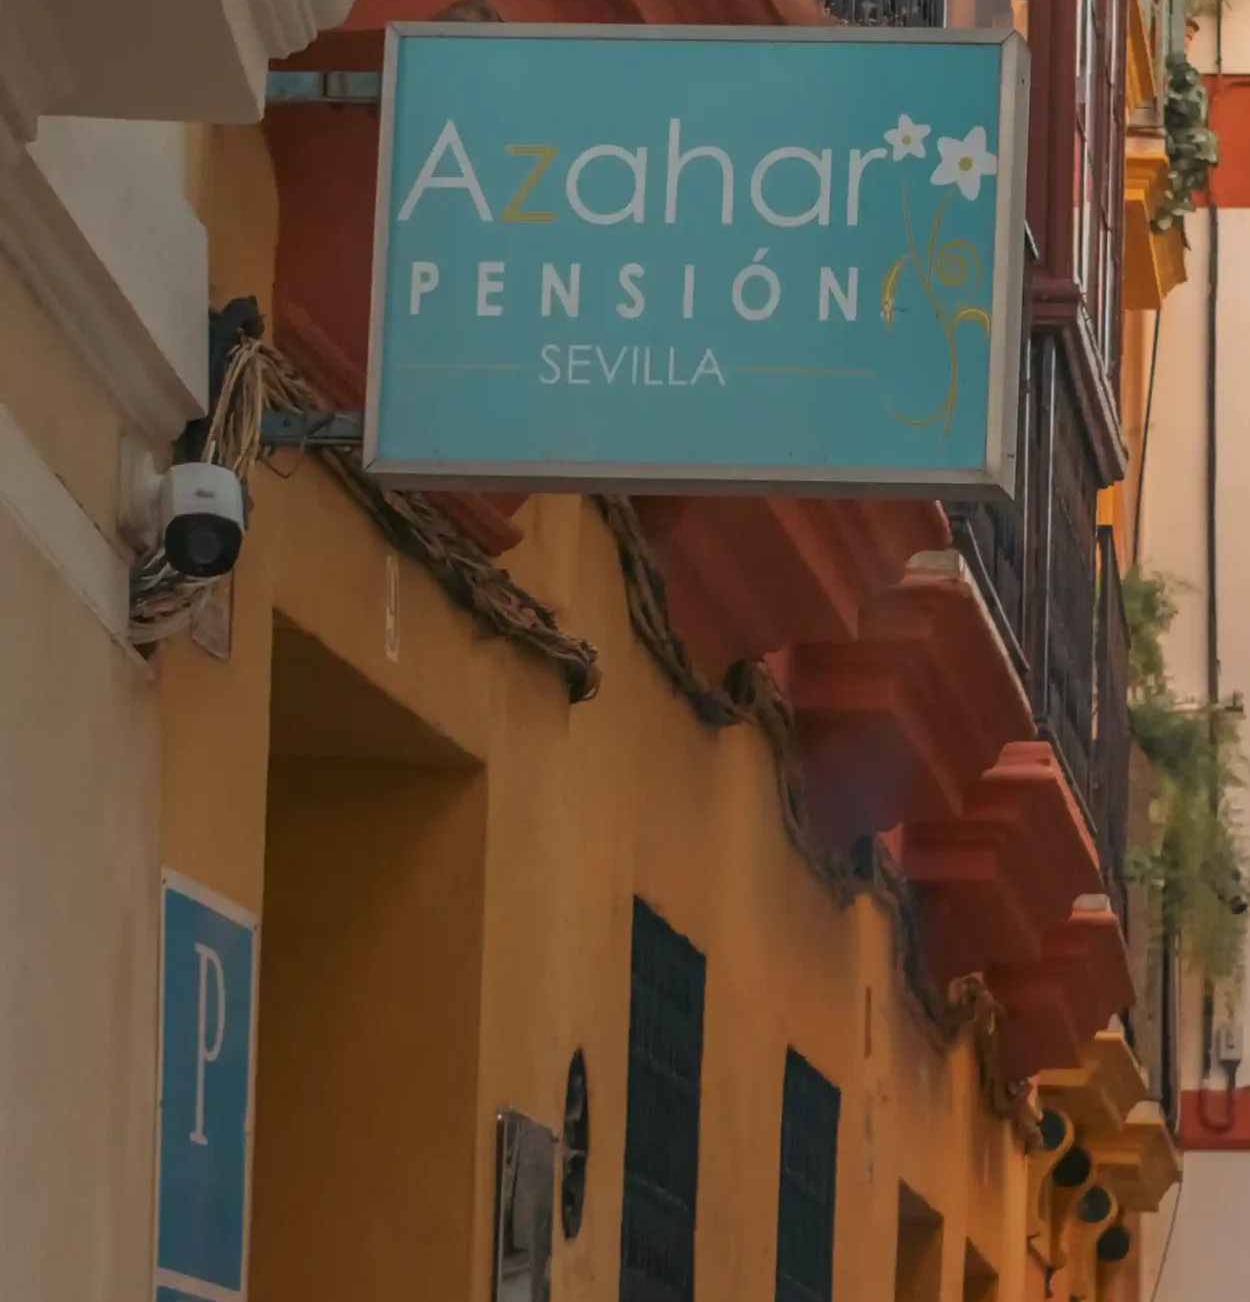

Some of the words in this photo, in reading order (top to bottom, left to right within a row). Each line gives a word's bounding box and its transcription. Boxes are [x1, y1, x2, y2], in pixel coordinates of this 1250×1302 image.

[397, 118, 887, 227] Azahar
[408, 248, 859, 322] PENSIÓN
[538, 344, 727, 387] SEVILLA
[189, 942, 226, 1146] P
